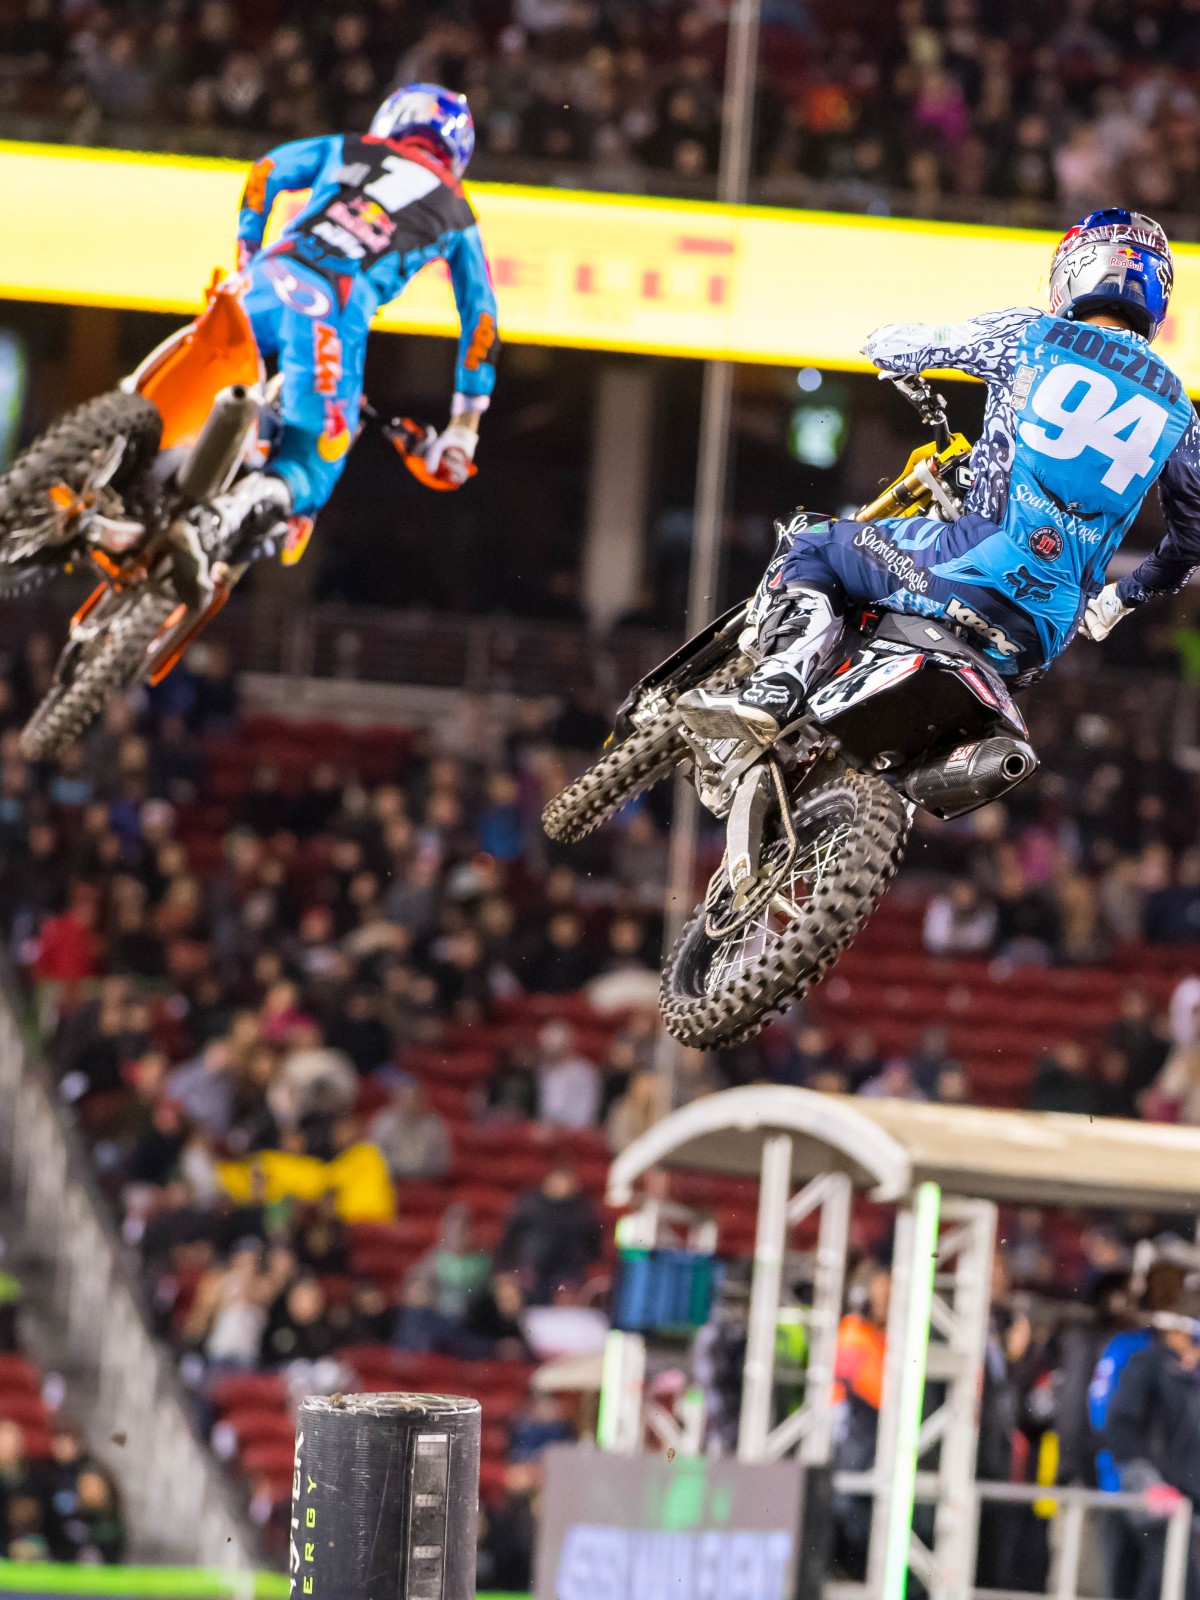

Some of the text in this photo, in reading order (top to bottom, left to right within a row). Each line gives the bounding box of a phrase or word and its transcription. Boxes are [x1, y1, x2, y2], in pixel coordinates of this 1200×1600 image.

[363, 155, 443, 214] 1
[1110, 258, 1144, 272] Red Bull
[1043, 321, 1183, 406] ROCZEN
[1018, 363, 1169, 495] 94
[302, 1474, 317, 1595] ERGY
